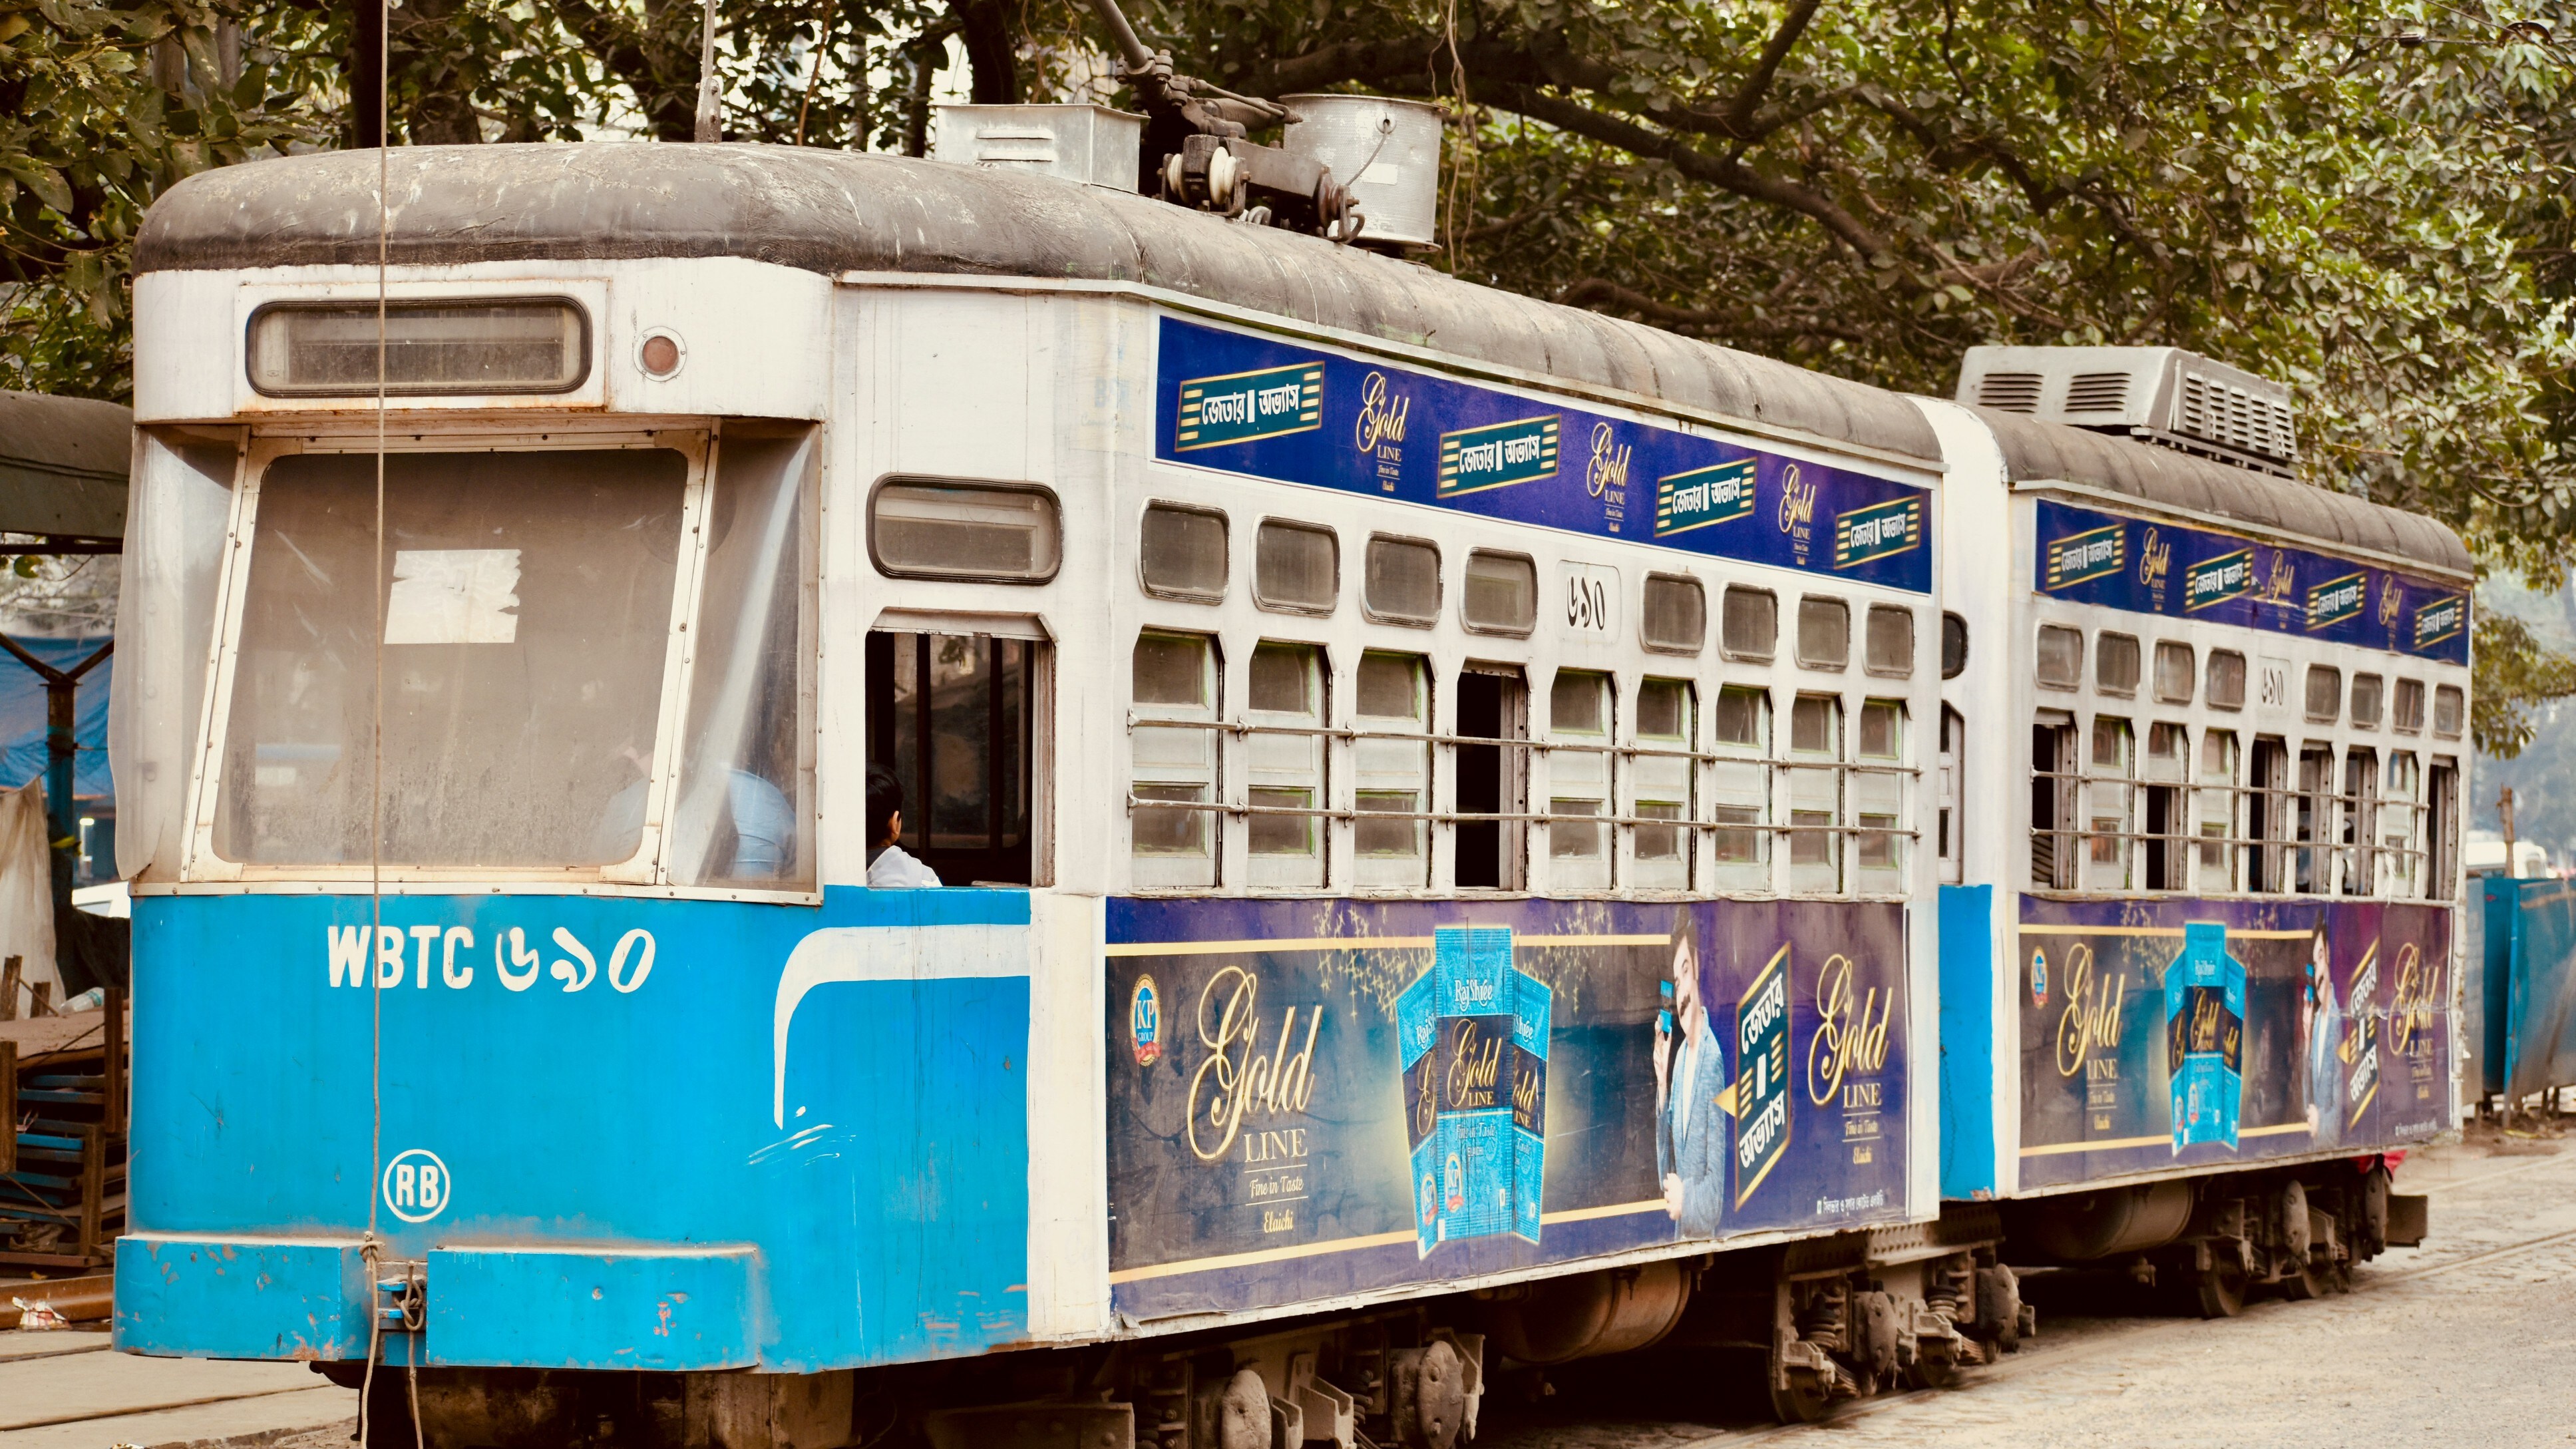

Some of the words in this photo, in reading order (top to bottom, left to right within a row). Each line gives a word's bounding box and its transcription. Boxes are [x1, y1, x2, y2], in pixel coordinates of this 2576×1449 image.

[1202, 391, 1245, 425] জেতার
[1258, 383, 1300, 415] অভ্যাস
[1356, 371, 1409, 453] Gold
[1377, 445, 1401, 462] LINE
[1459, 441, 1495, 473] জেতার
[1505, 435, 1540, 464] অভ্যাস
[1586, 421, 1632, 497] Gold
[1604, 489, 1625, 505] LINE
[1672, 485, 1702, 515] জেতার
[1711, 477, 1741, 504] অভ্যাস
[1779, 464, 1817, 534] Gold
[1793, 526, 1810, 540] LINE
[1850, 521, 1874, 548] জেতার
[1882, 513, 1907, 538] অভ্যাস
[2139, 526, 2171, 586] Gold
[1566, 576, 1605, 631] ৬১০
[327, 925, 473, 989] WBTC
[495, 927, 655, 993] ৬১০
[1137, 999, 1155, 1029] KP
[1741, 972, 1784, 1055] জেতার
[1807, 953, 1893, 1106] Gold
[2056, 942, 2125, 1077] Gold
[1137, 1032, 1153, 1042] GROUP
[1187, 965, 1323, 1161] Gold
[1447, 1018, 1503, 1108] Gold
[2086, 1058, 2118, 1080] LINE
[1468, 1091, 1495, 1107] LINE
[1513, 1065, 1538, 1114] old
[1843, 1082, 1882, 1109] LINE
[1515, 1110, 1531, 1129] INE
[1739, 1089, 1785, 1169] অভ্যাস
[1243, 1128, 1308, 1163] LINE
[396, 1164, 439, 1208] RB
[1249, 1177, 1268, 1199] Fine
[1269, 1176, 1279, 1194] in
[1280, 1175, 1304, 1193] Taste
[1264, 1209, 1294, 1233] Elaichi
